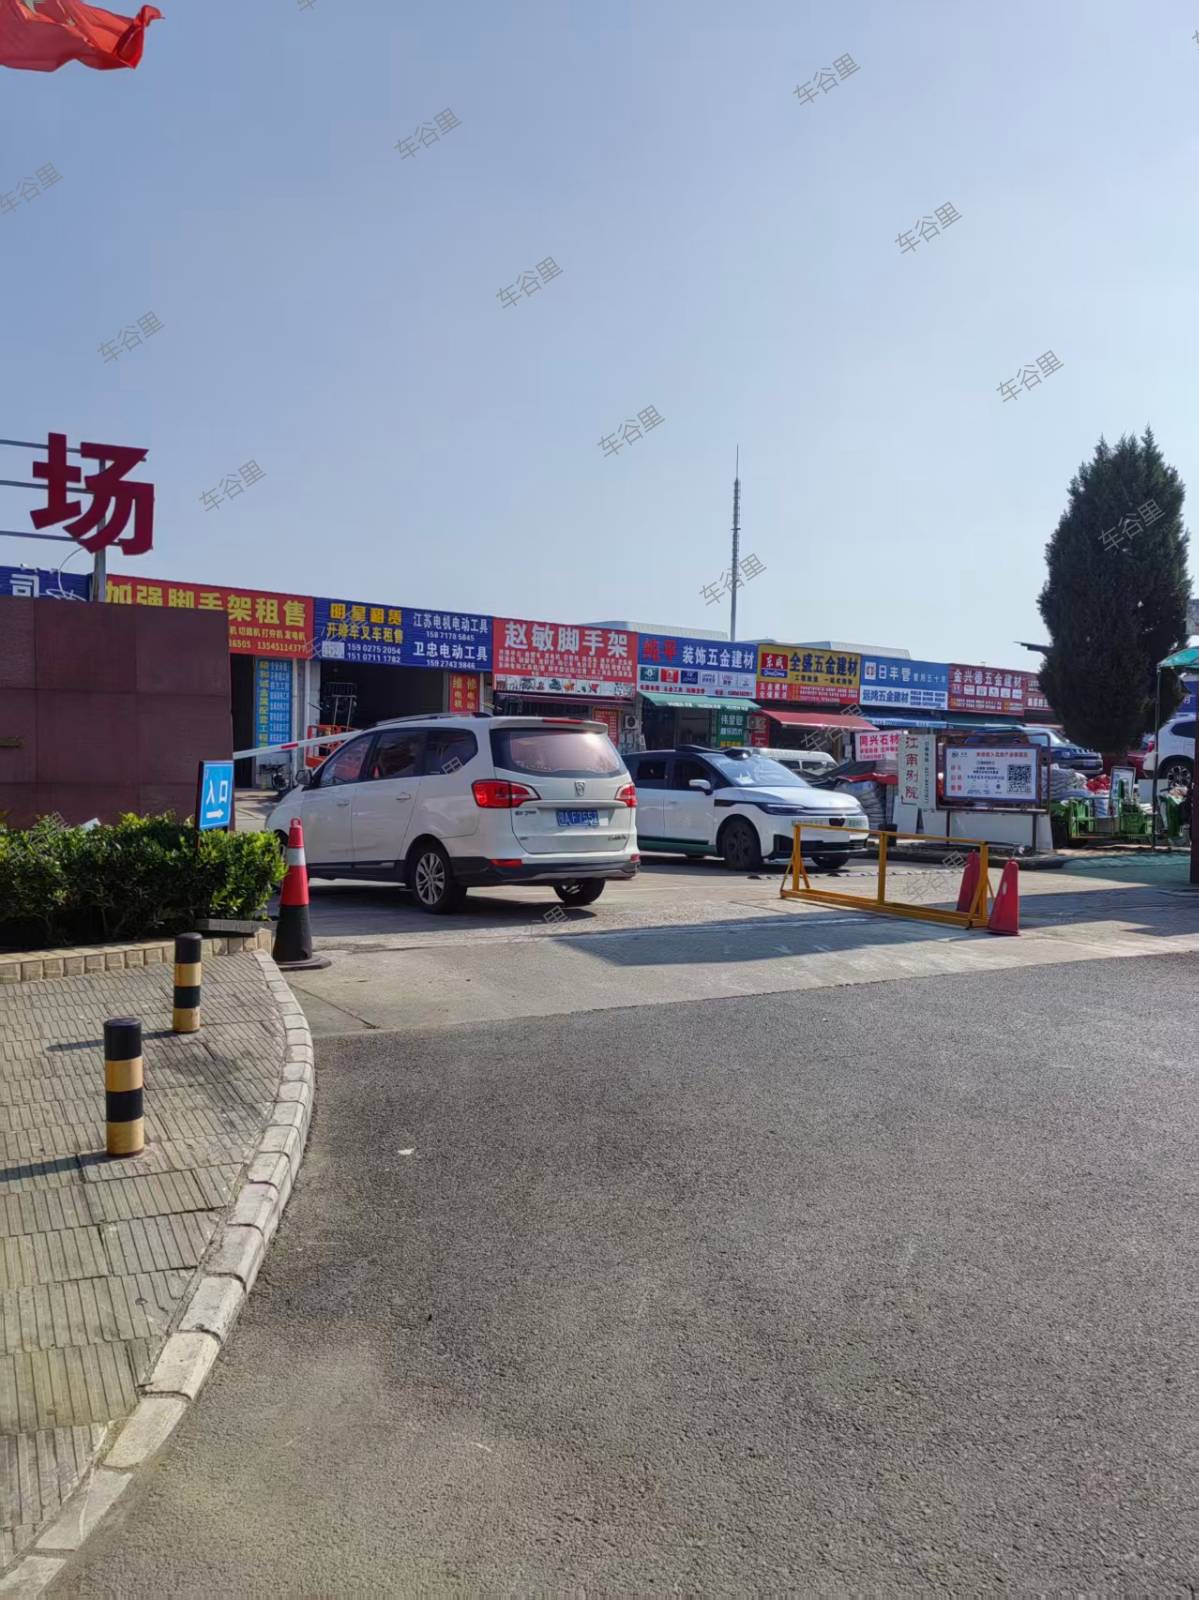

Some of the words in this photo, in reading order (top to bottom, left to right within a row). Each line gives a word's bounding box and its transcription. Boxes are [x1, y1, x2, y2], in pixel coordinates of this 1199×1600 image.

[29, 432, 155, 555] 场
[10, 575, 40, 597] 司
[106, 582, 305, 627] 加强脚手架租售
[412, 641, 488, 662] 卫忠电动工具
[504, 621, 628, 658] 赵敏脚手架
[682, 645, 754, 669] 装饰五金建材
[206, 780, 228, 804] 入口
